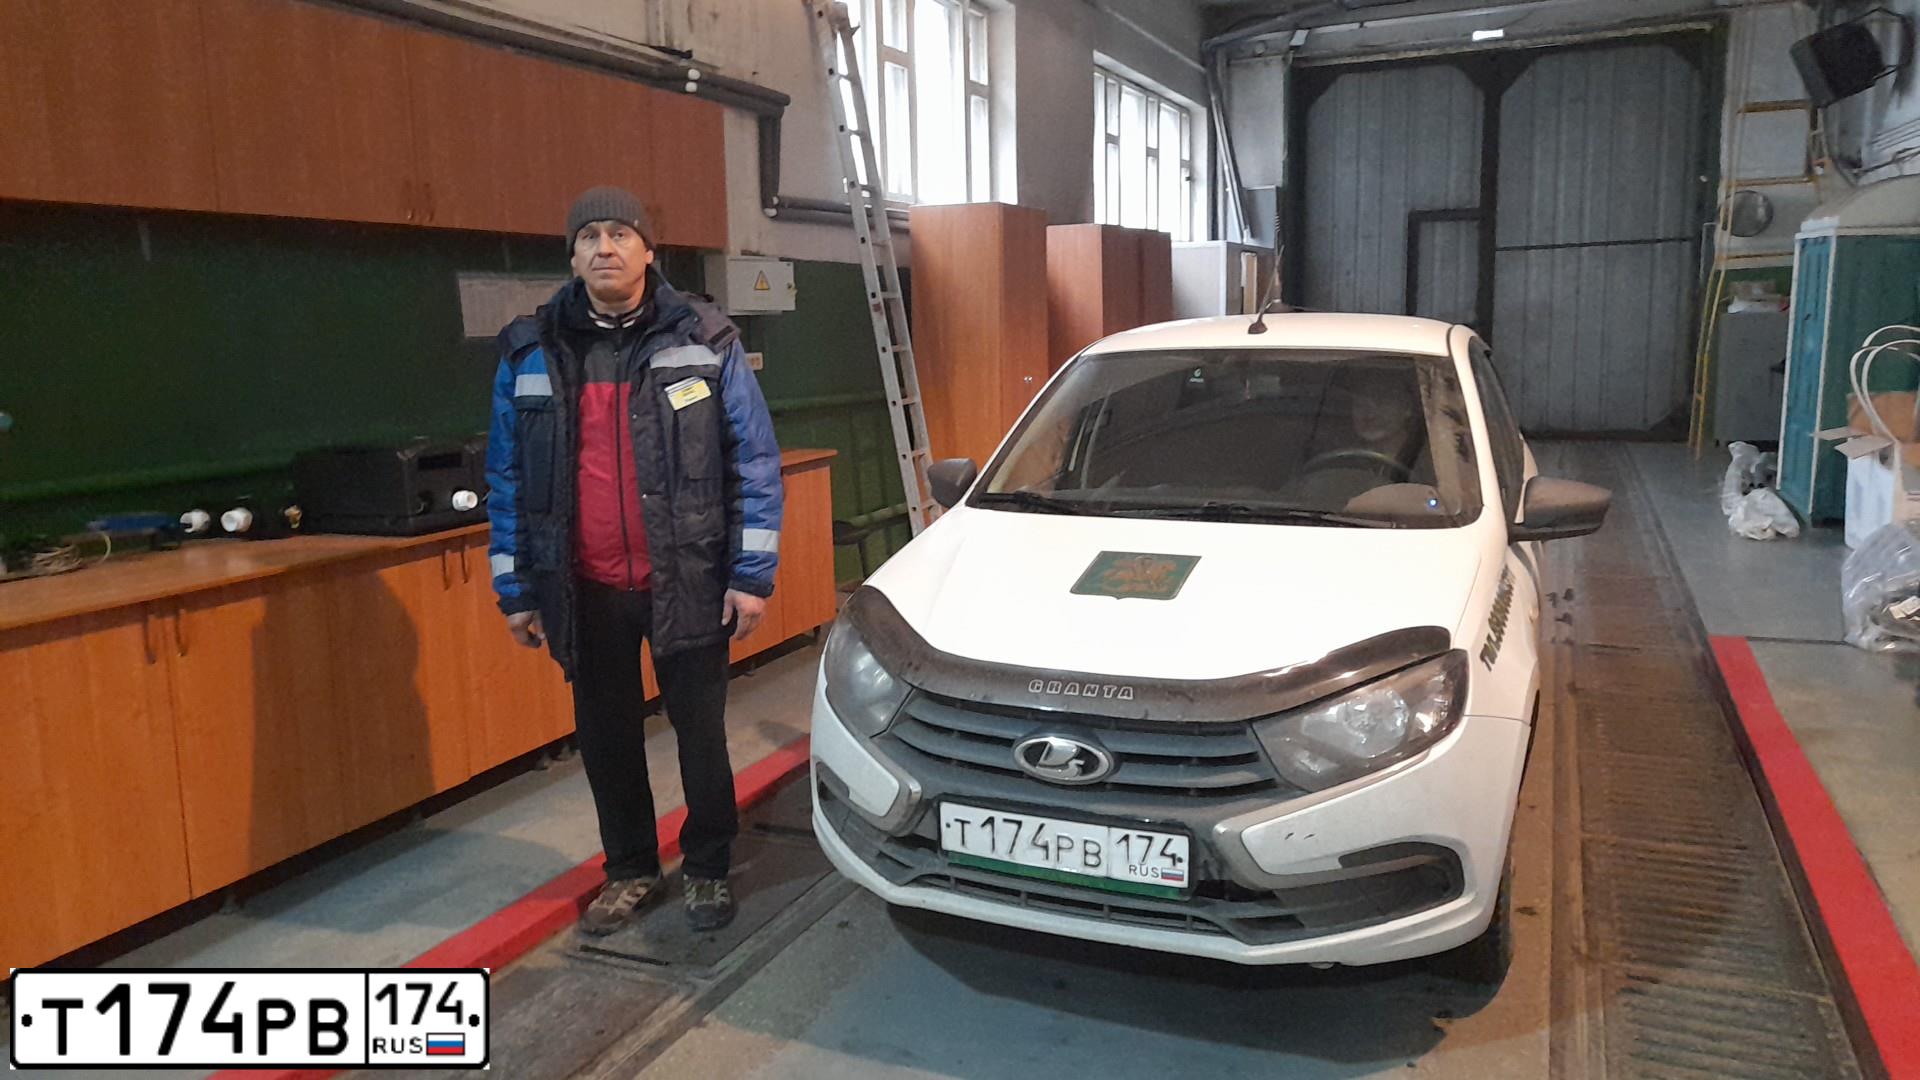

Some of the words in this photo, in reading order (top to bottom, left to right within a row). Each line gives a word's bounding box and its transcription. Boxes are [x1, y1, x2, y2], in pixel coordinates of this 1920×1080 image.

[1028, 679, 1133, 700] GRANTA
[1117, 834, 1177, 867] 174
[1129, 864, 1160, 878] RUS
